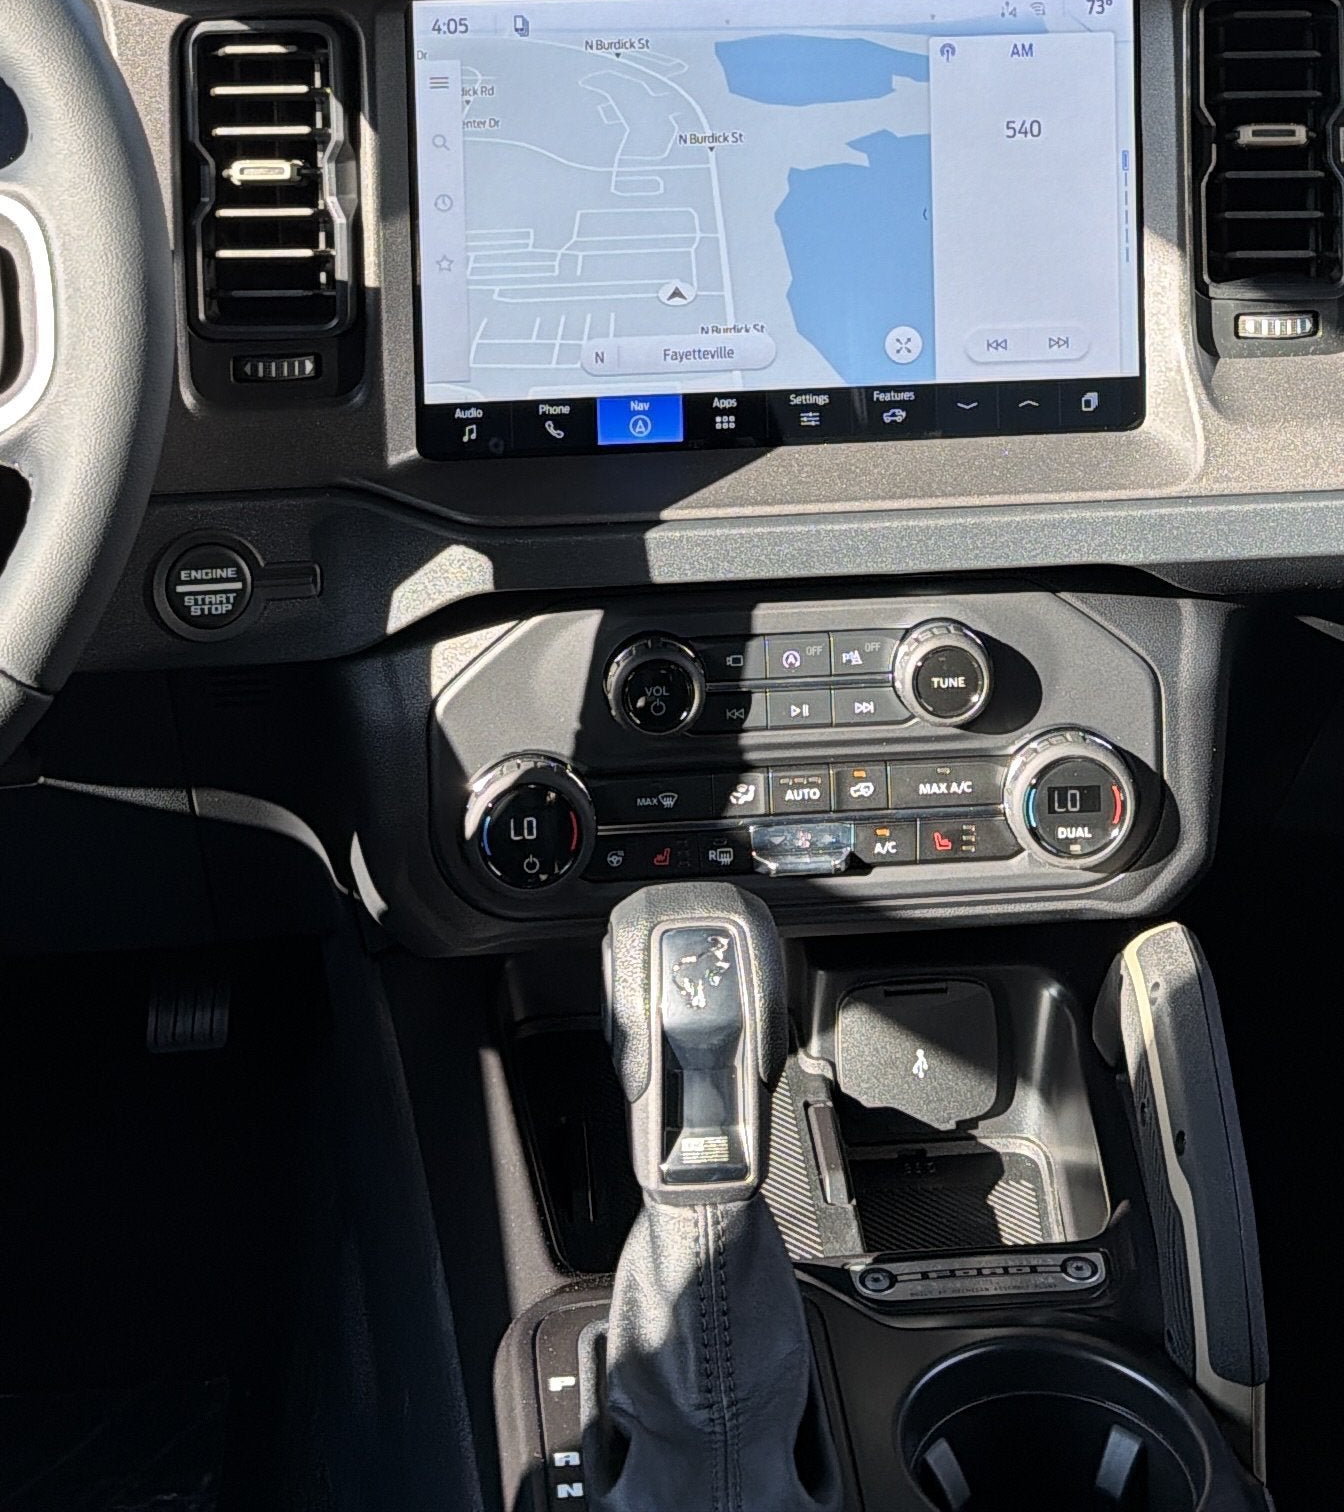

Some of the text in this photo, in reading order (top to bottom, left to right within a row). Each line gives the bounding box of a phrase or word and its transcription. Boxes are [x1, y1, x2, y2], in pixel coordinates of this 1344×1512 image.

[431, 16, 470, 36] 4:05
[584, 37, 651, 51] N Burdick St
[1009, 43, 1035, 58] AM
[416, 49, 429, 62] Dr
[479, 84, 495, 98] Rd
[487, 117, 501, 129] Dr
[1005, 119, 1042, 139] 540
[678, 131, 745, 145] N Burdick St
[701, 324, 709, 335] N
[594, 345, 735, 364] N Fayetteville
[789, 392, 830, 406] Settings
[872, 390, 916, 402] Features
[538, 403, 571, 416] Phone
[630, 400, 650, 412] Nav
[711, 396, 738, 411] Apps
[454, 406, 484, 419] Audio
[180, 568, 238, 581] ENGINE
[184, 593, 237, 606] START
[190, 603, 233, 616] STOP
[805, 645, 824, 657] OFF
[863, 641, 882, 654] OFF
[931, 677, 966, 689] TUNE
[644, 686, 670, 697] VOL
[918, 780, 973, 795] MAX A/C
[784, 788, 821, 801] AUTO
[636, 797, 658, 807] MAX
[1057, 825, 1093, 839] DUAL
[873, 841, 898, 855] A/C
[549, 1376, 576, 1392] P
[553, 1451, 581, 1467] R
[557, 1482, 584, 1499] N
